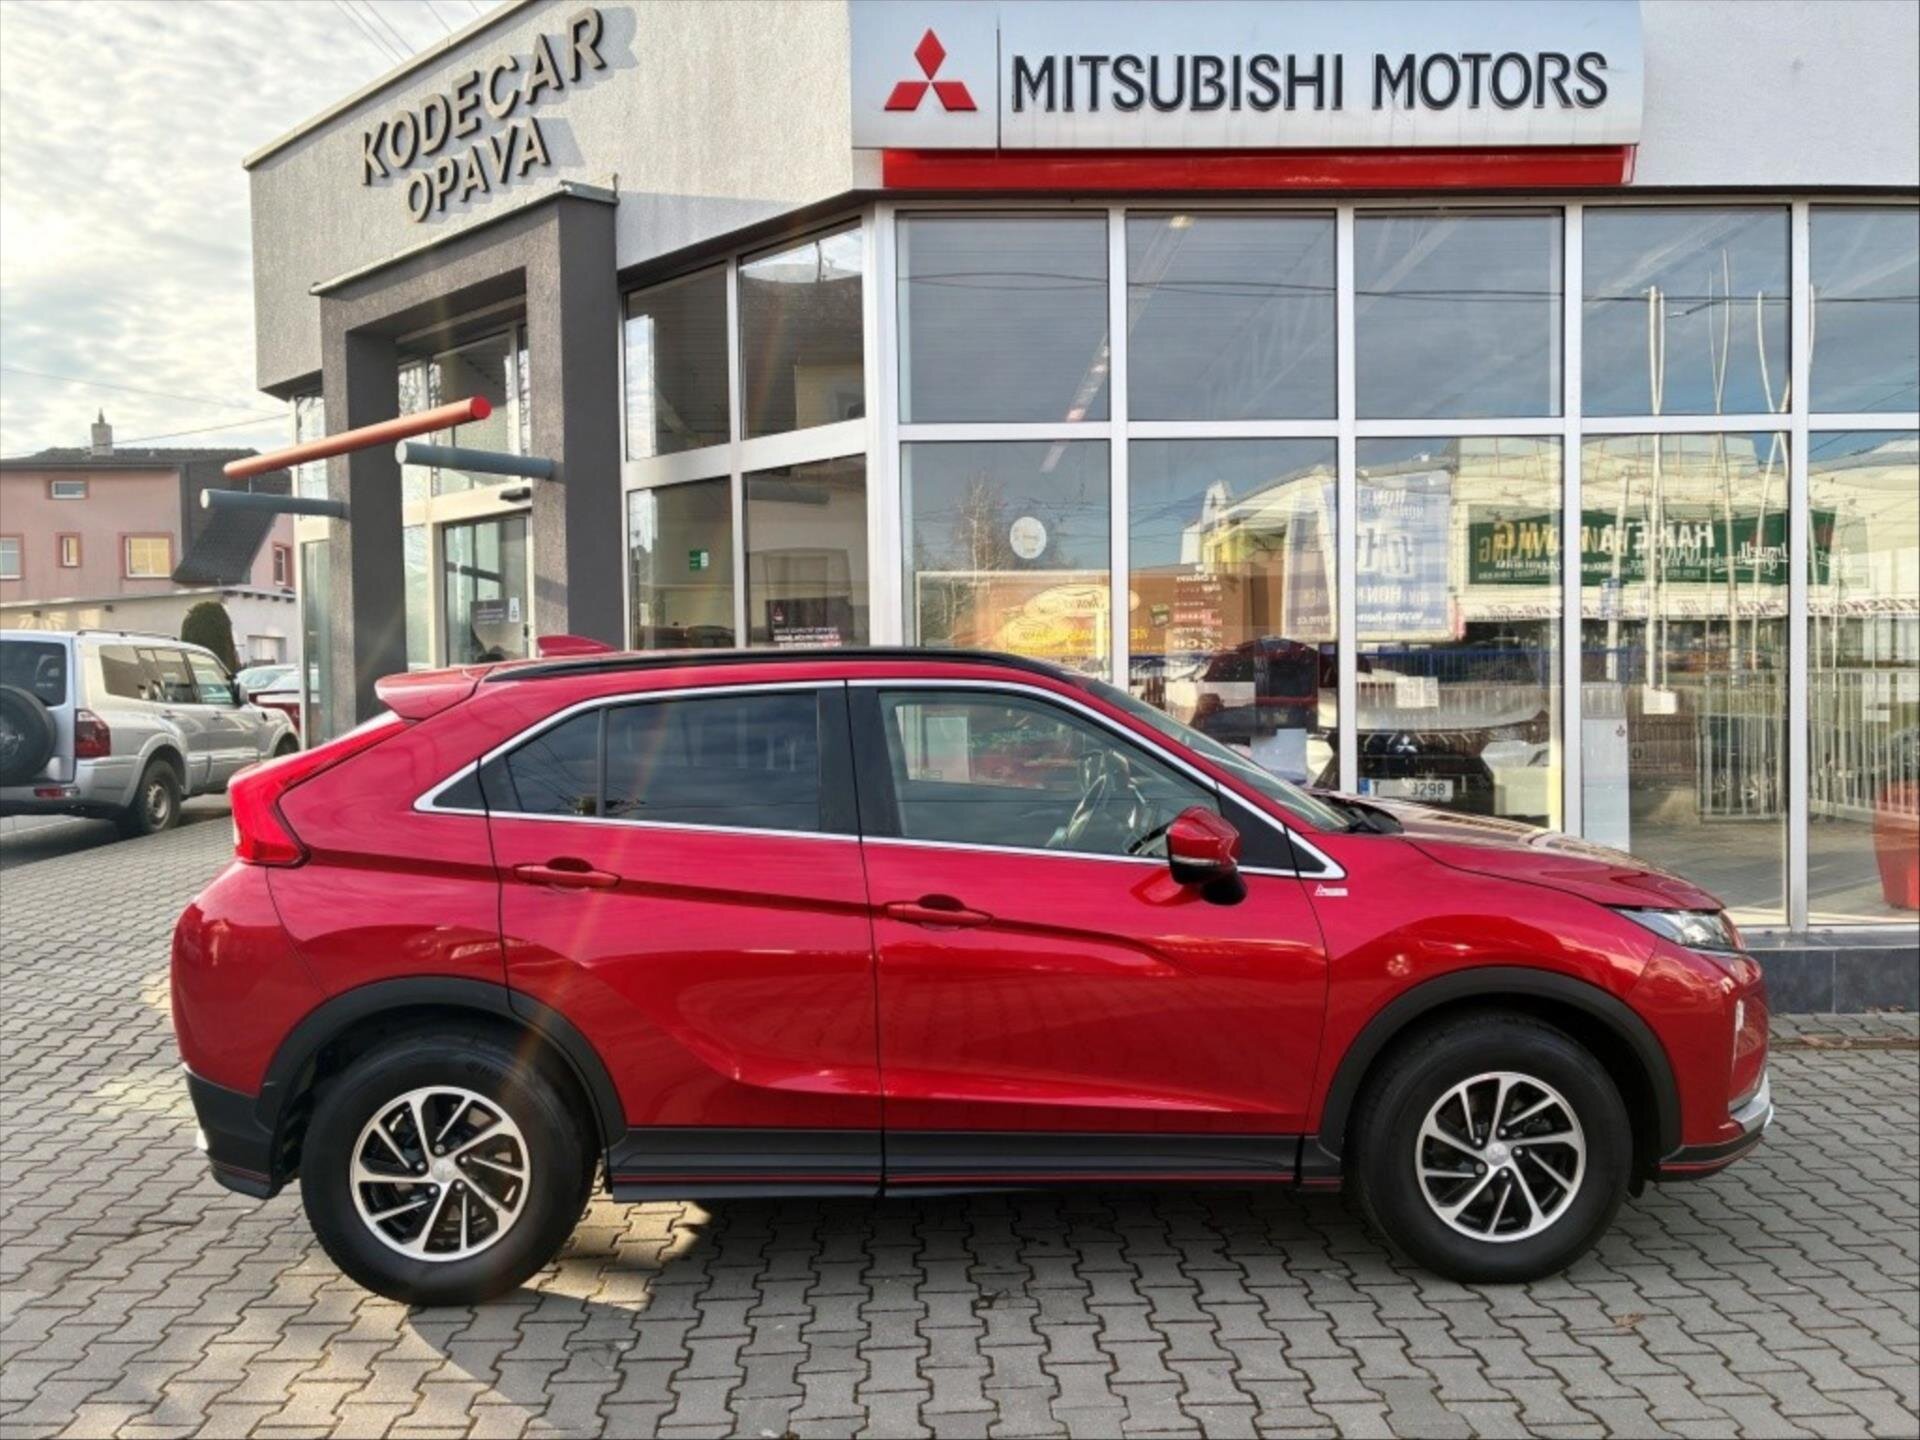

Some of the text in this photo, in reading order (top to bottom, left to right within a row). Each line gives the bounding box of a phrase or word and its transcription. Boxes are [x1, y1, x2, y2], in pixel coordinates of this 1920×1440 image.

[362, 7, 607, 185] KODECAR
[1012, 51, 1608, 114] MITSUBISHI MOTORS
[405, 117, 551, 223] OPAVA
